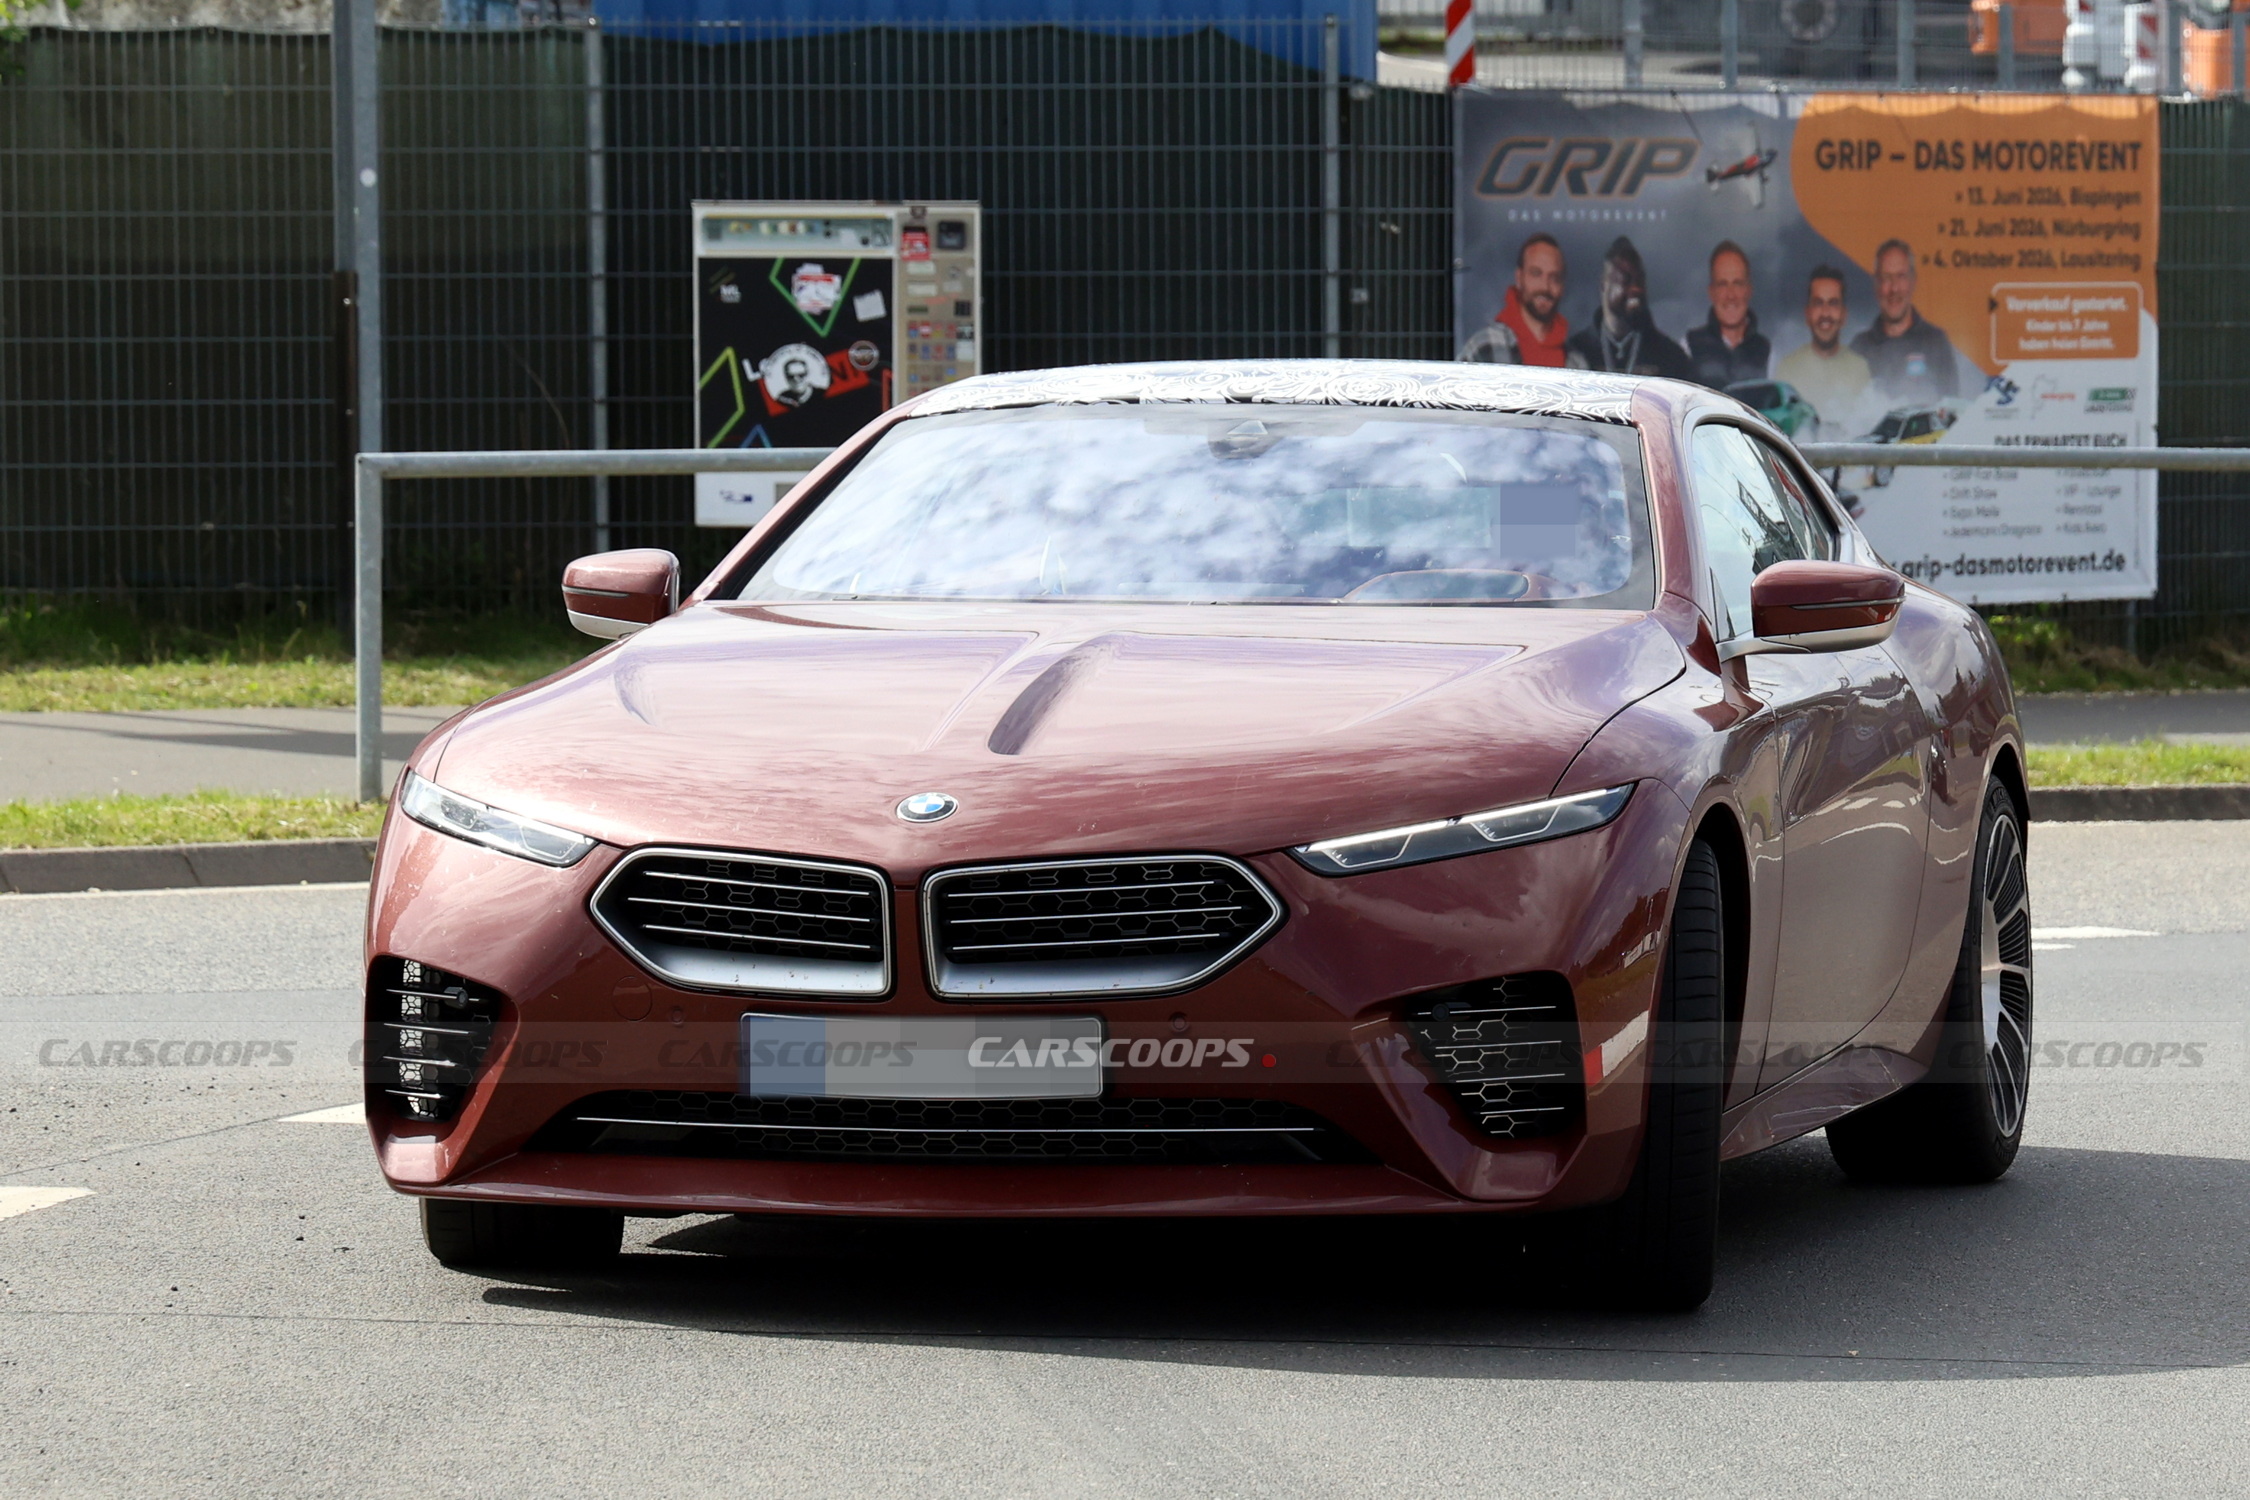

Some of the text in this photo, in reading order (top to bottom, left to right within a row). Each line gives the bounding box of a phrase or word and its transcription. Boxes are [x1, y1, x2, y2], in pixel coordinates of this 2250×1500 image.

[1814, 139, 1882, 172] GRIP
[1914, 140, 1965, 172] DAS
[1972, 140, 2142, 172] MOTOREVENT
[1475, 136, 1701, 200] GRIP
[1992, 187, 2024, 206] Juni
[1507, 209, 1667, 222] DAS MOTOREVENT
[1974, 218, 2008, 237] Juni
[1952, 251, 2014, 268] Oktober
[1891, 547, 2126, 583] grip-dasmotorevent.de
